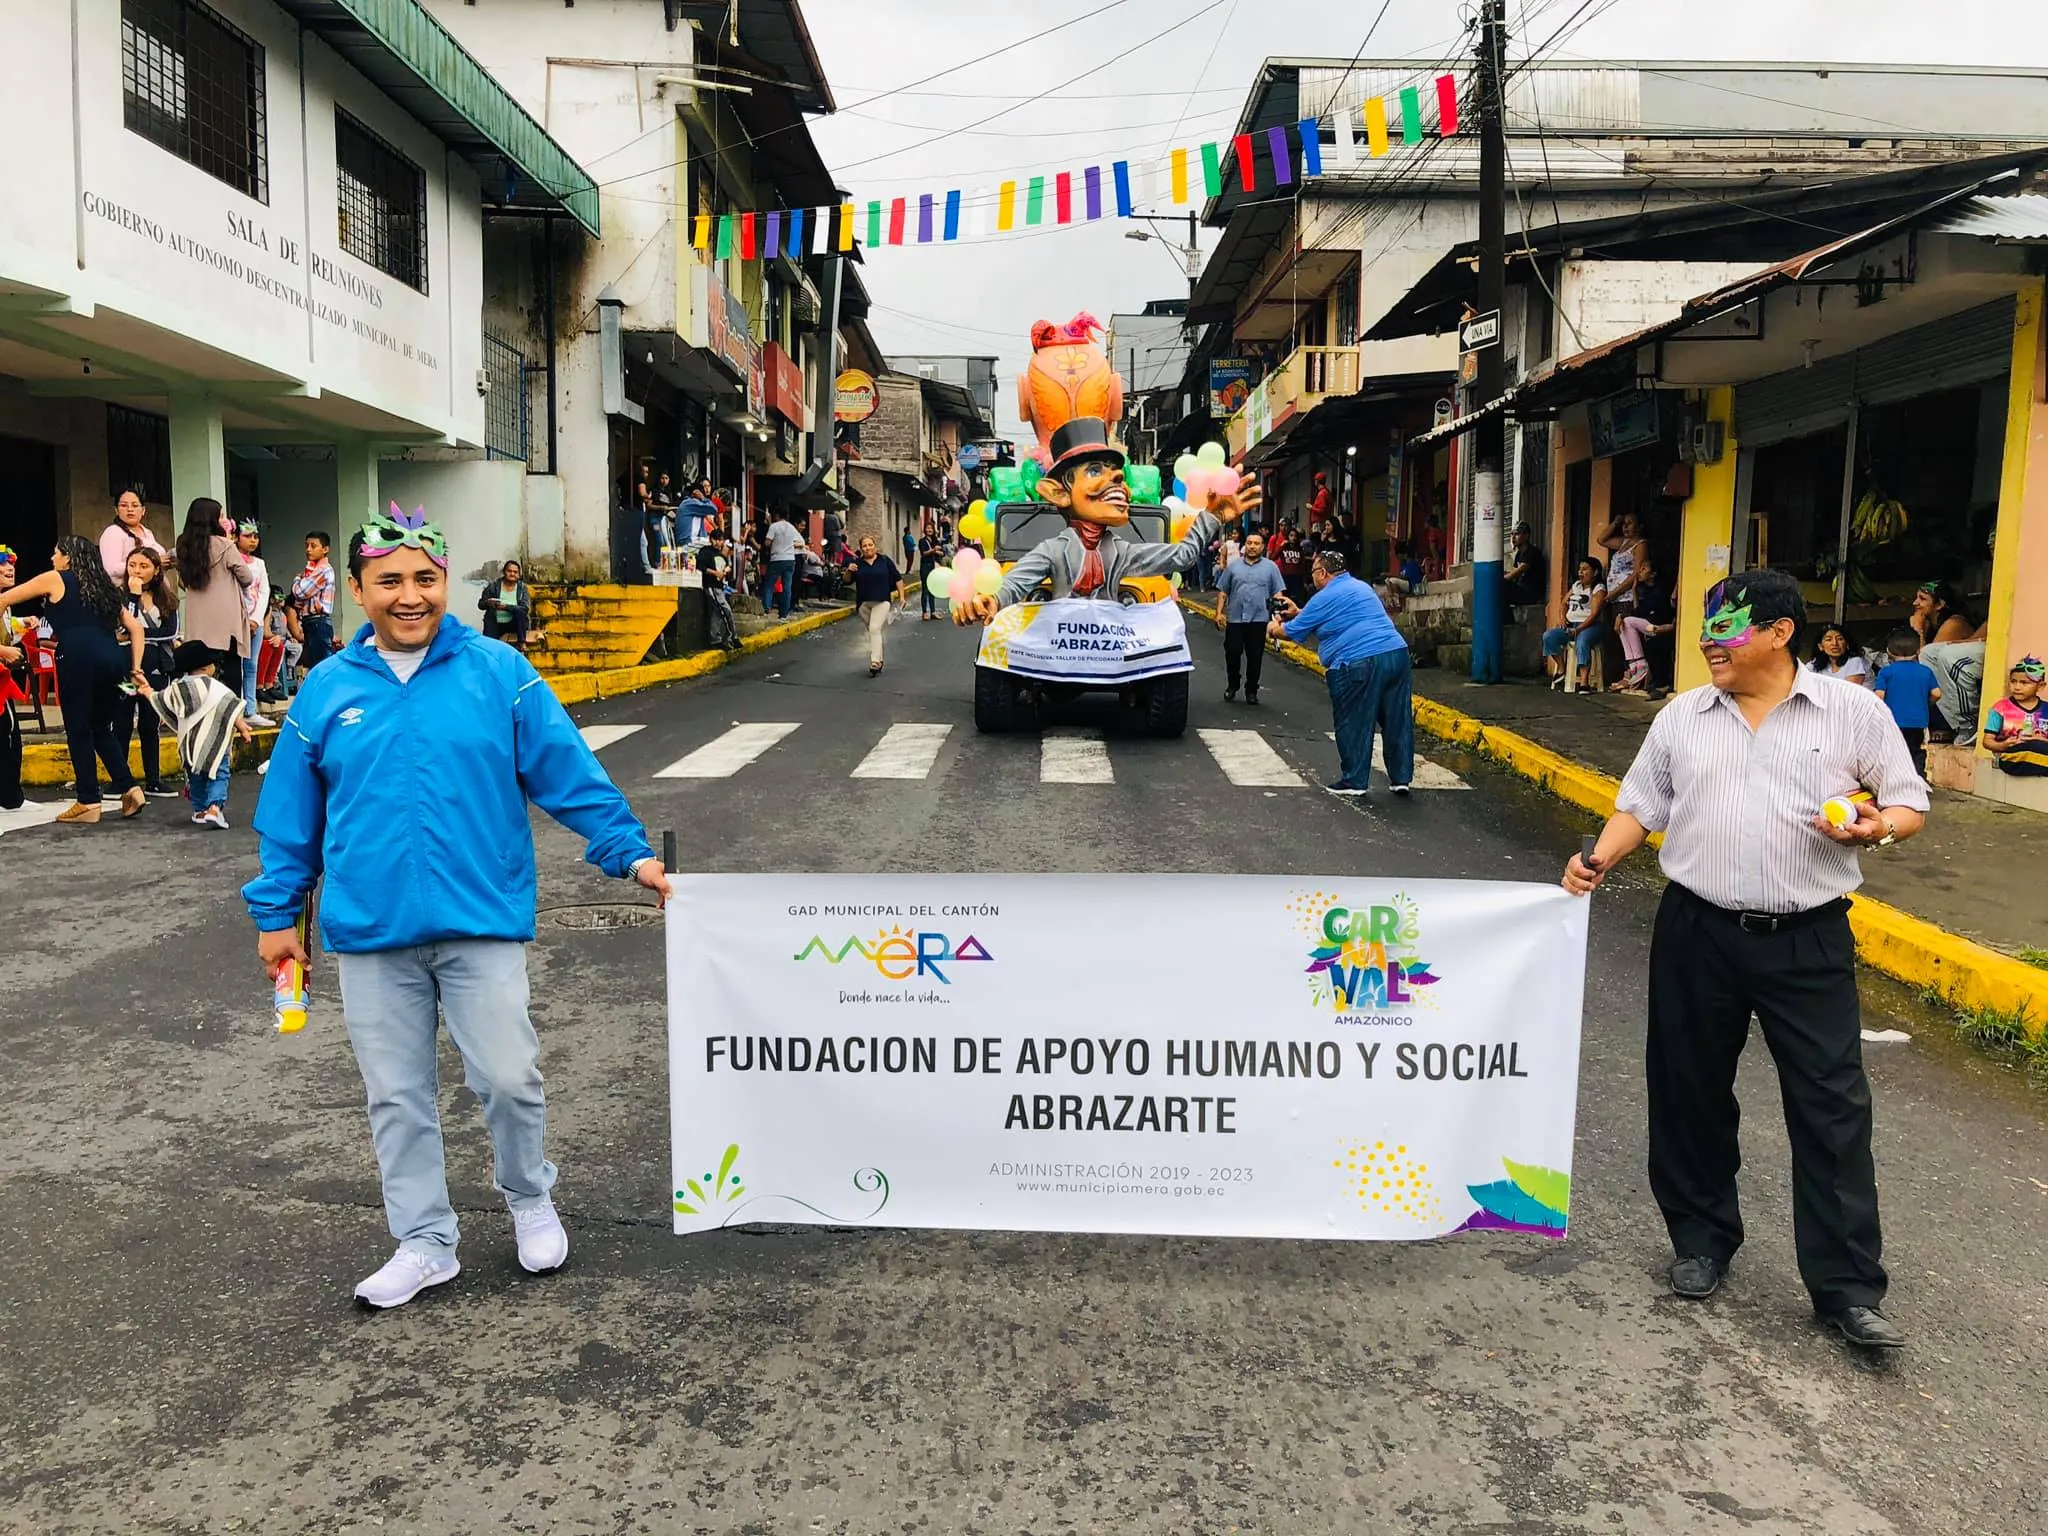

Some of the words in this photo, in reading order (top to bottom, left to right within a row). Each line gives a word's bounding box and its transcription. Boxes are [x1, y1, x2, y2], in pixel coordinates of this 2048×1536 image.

[227, 210, 269, 251] SALA
[279, 236, 299, 266] DE
[311, 252, 383, 310] REUNIONES
[83, 191, 164, 244] GOBIERNO
[168, 232, 243, 279] AUTONOMO
[246, 267, 347, 328] DESCENTRALIZADO
[352, 318, 398, 352] MUNICIPAL
[403, 343, 413, 359] DE
[417, 349, 438, 370] MERA
[1471, 325, 1482, 339] UNA
[1484, 323, 1494, 335] VIA
[1057, 622, 1136, 637] FUNDACIÓN
[788, 905, 818, 916] GAD
[824, 905, 902, 916] MUNICIPAL
[909, 905, 935, 916] DEL
[942, 903, 999, 916] CANTÓN
[839, 989, 872, 1004] Donde
[875, 994, 901, 1004] nace
[904, 989, 915, 1003] la
[1335, 1012, 1413, 1026] AMAZÓNICO
[706, 1035, 937, 1074] FUNDACION
[953, 1037, 1002, 1074] DE
[1015, 1037, 1150, 1076] APOYO
[1166, 1039, 1341, 1079] HUMANO
[1356, 1042, 1381, 1079] Y
[1396, 1041, 1528, 1081] SOCIAL
[1004, 1094, 1236, 1134] ABRAZARTE
[988, 1162, 1143, 1179] ADMINISTRACIÓN
[1149, 1166, 1190, 1180] 2019
[1209, 1167, 1254, 1182] 2023
[1016, 1181, 1225, 1197] www.municipiomera.gob.ec
